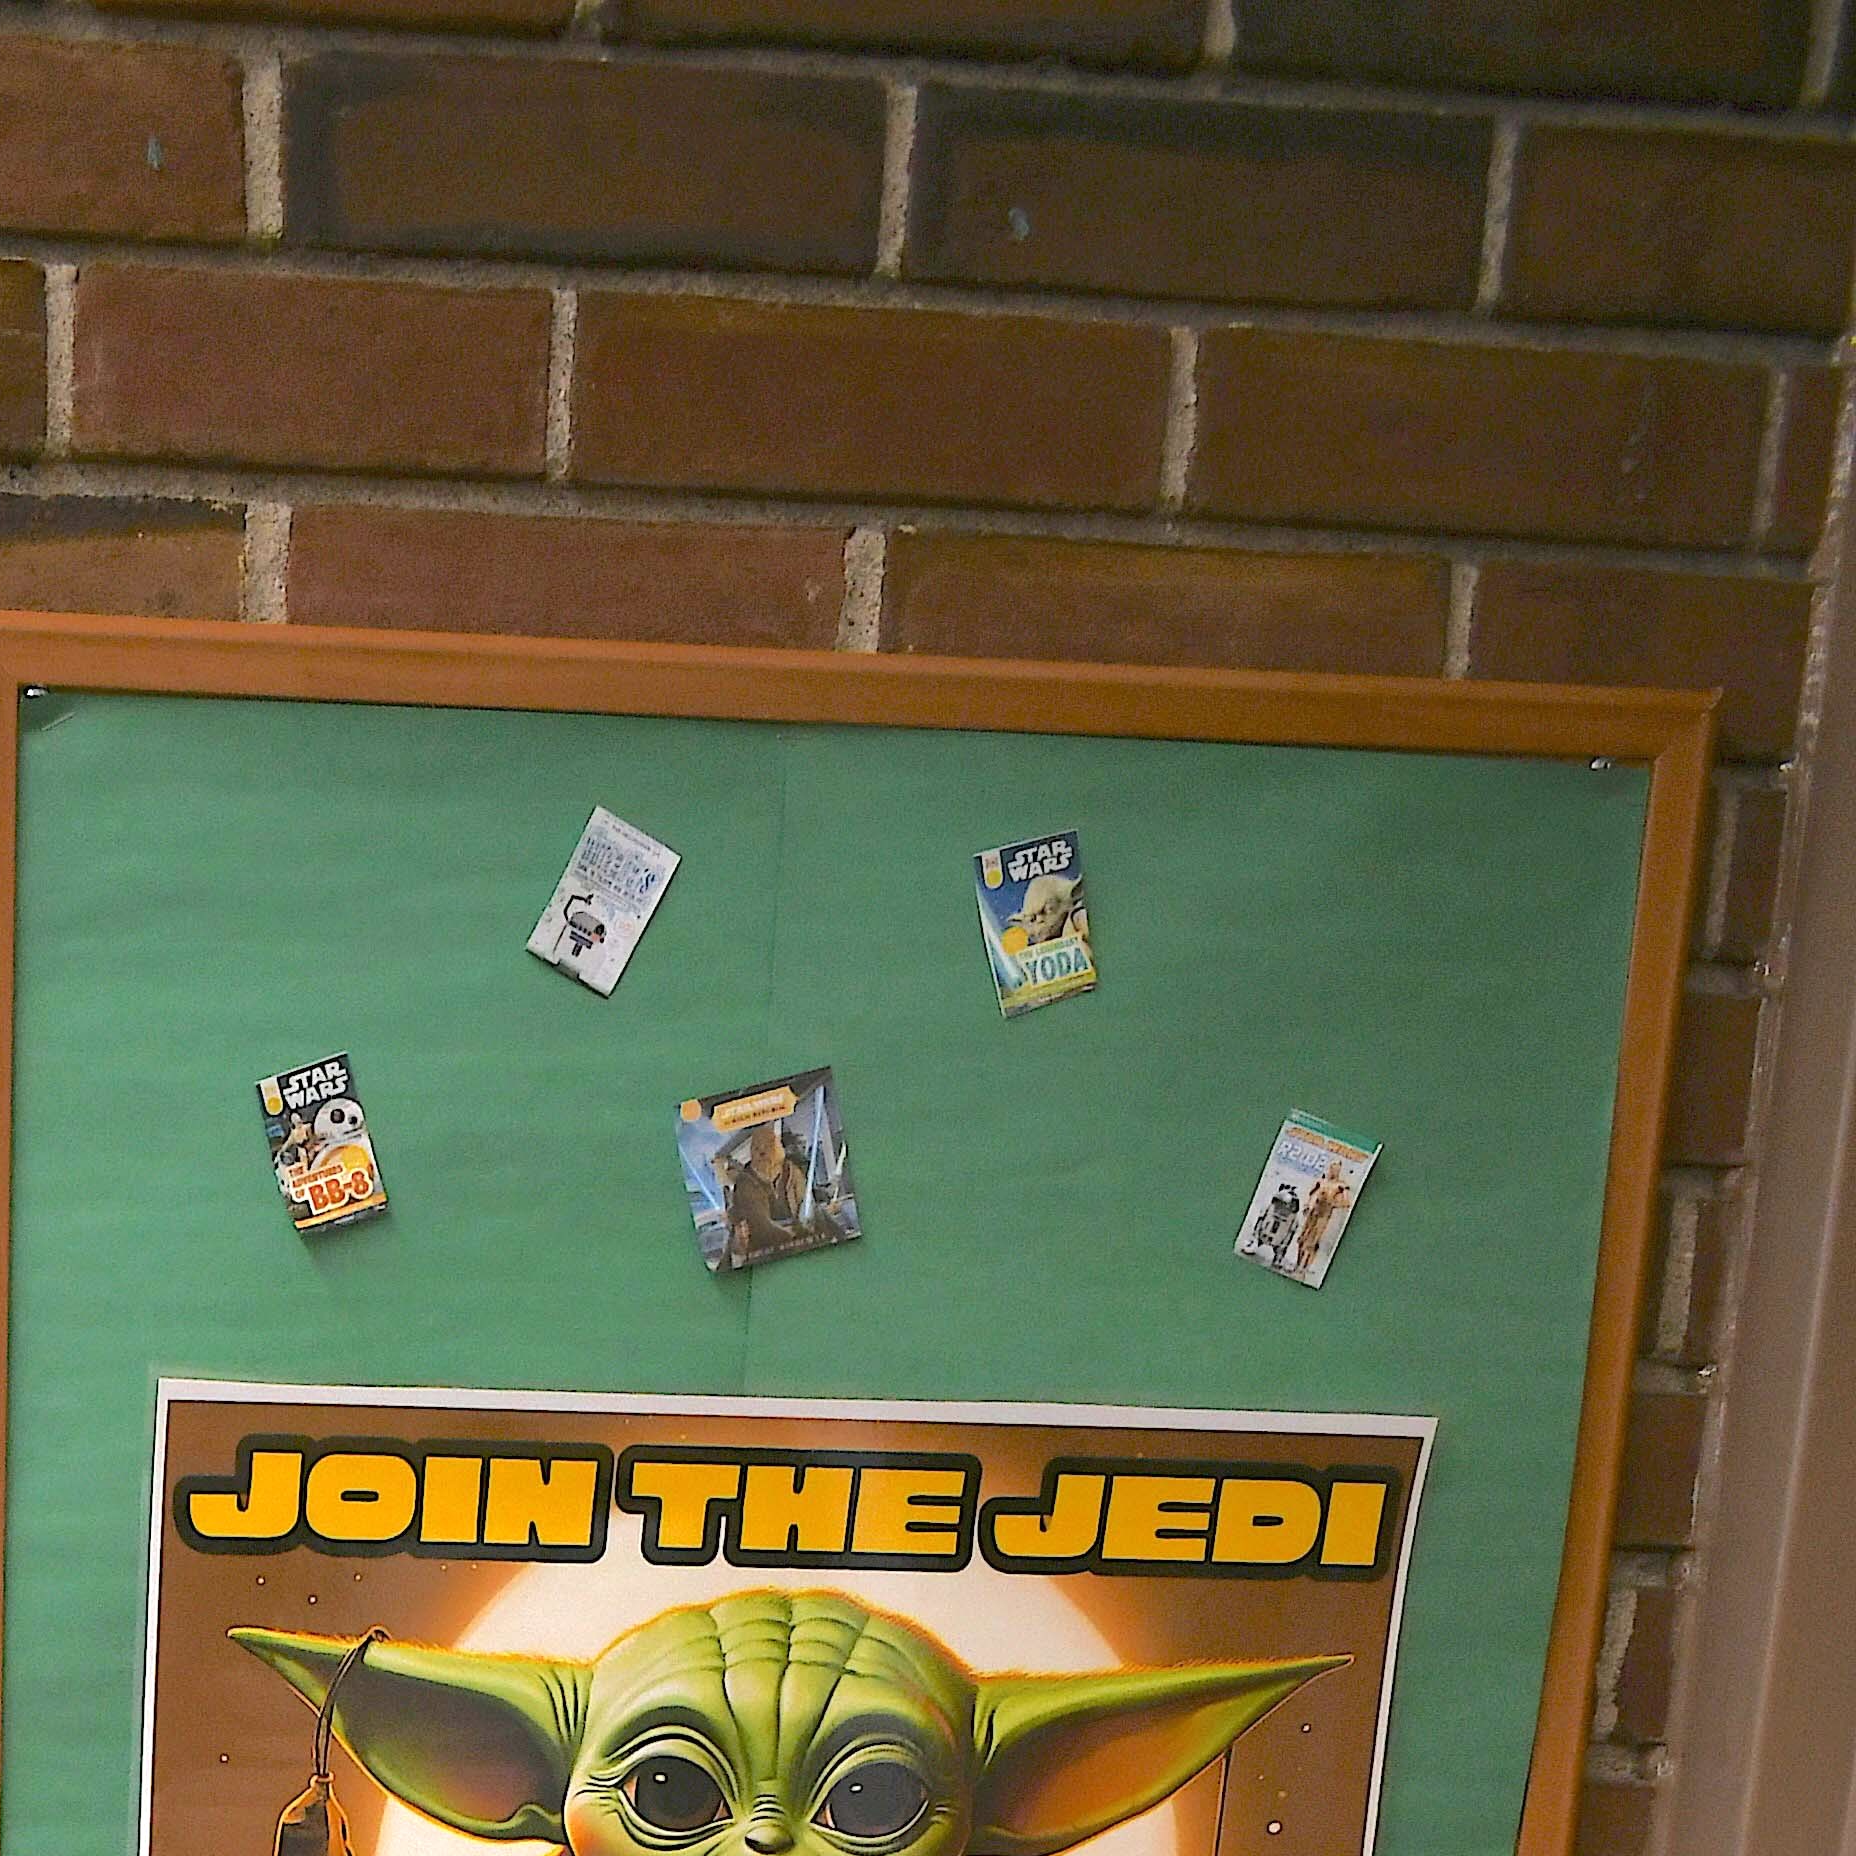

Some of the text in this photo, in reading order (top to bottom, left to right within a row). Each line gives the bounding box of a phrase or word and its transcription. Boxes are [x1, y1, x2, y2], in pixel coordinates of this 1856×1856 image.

[1008, 840, 1073, 867] STAR
[1008, 852, 1073, 882] WARS
[1026, 947, 1088, 985] YODA
[283, 1061, 346, 1094] STAR
[284, 1074, 348, 1109] WARS
[309, 1170, 369, 1211] BB-8
[190, 1452, 1386, 1565] JOIN THE JEDI
